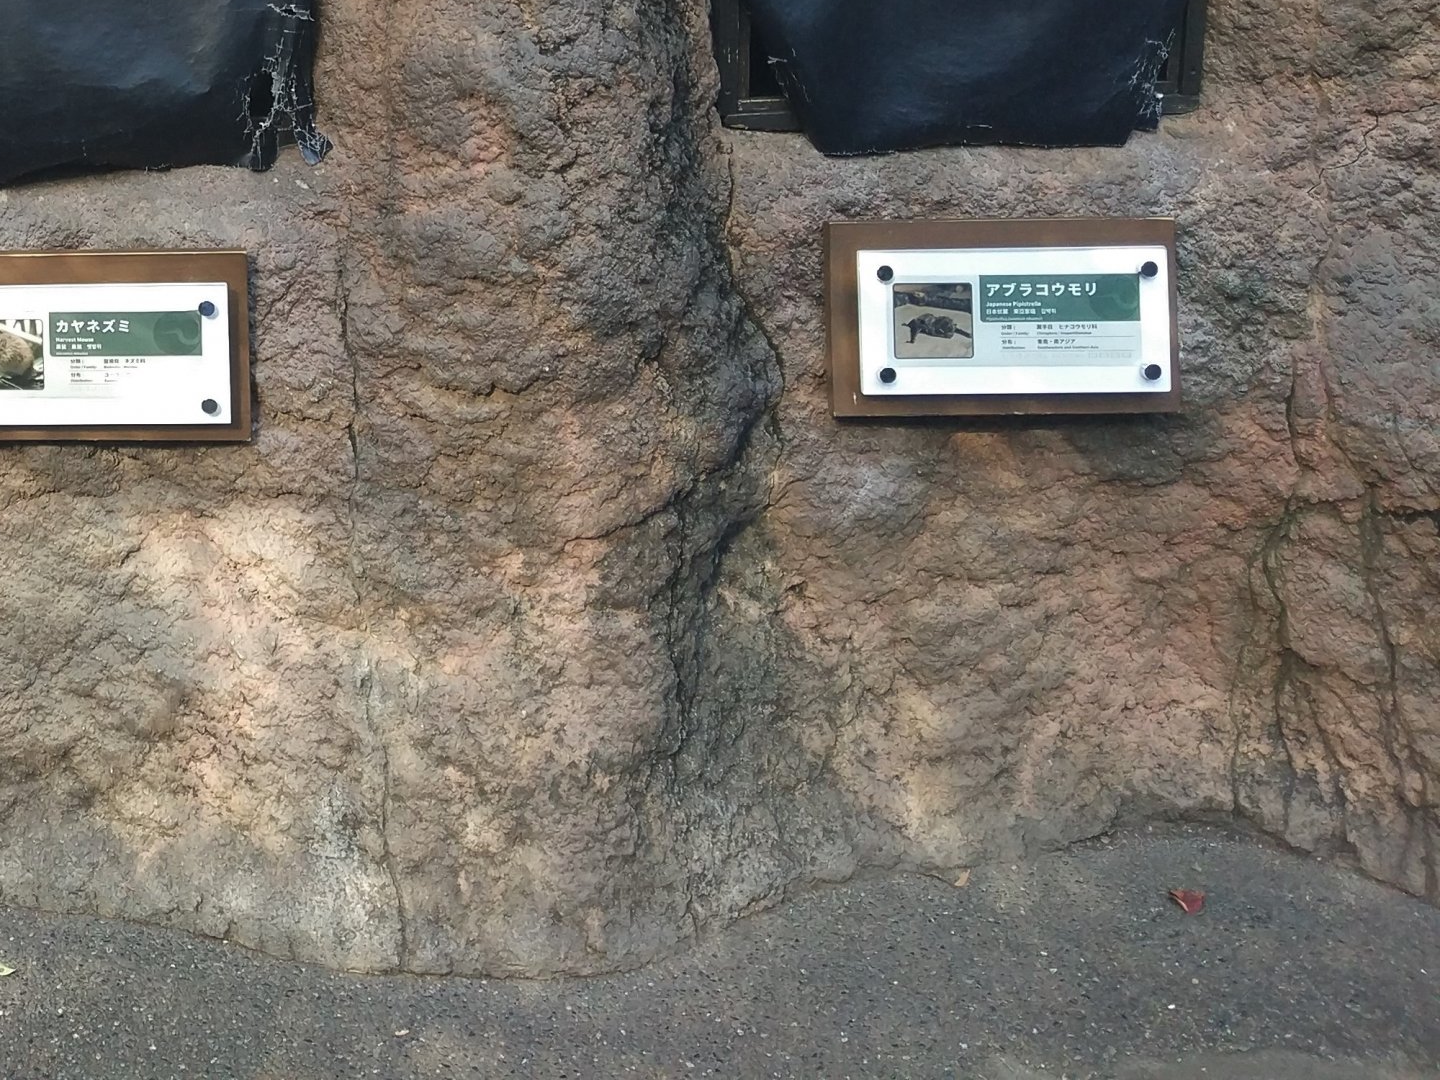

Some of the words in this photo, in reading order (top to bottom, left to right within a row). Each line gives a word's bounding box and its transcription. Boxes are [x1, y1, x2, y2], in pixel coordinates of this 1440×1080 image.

[986, 282, 1096, 296] アブラコウモリ
[56, 319, 130, 333] カヤネズミ
